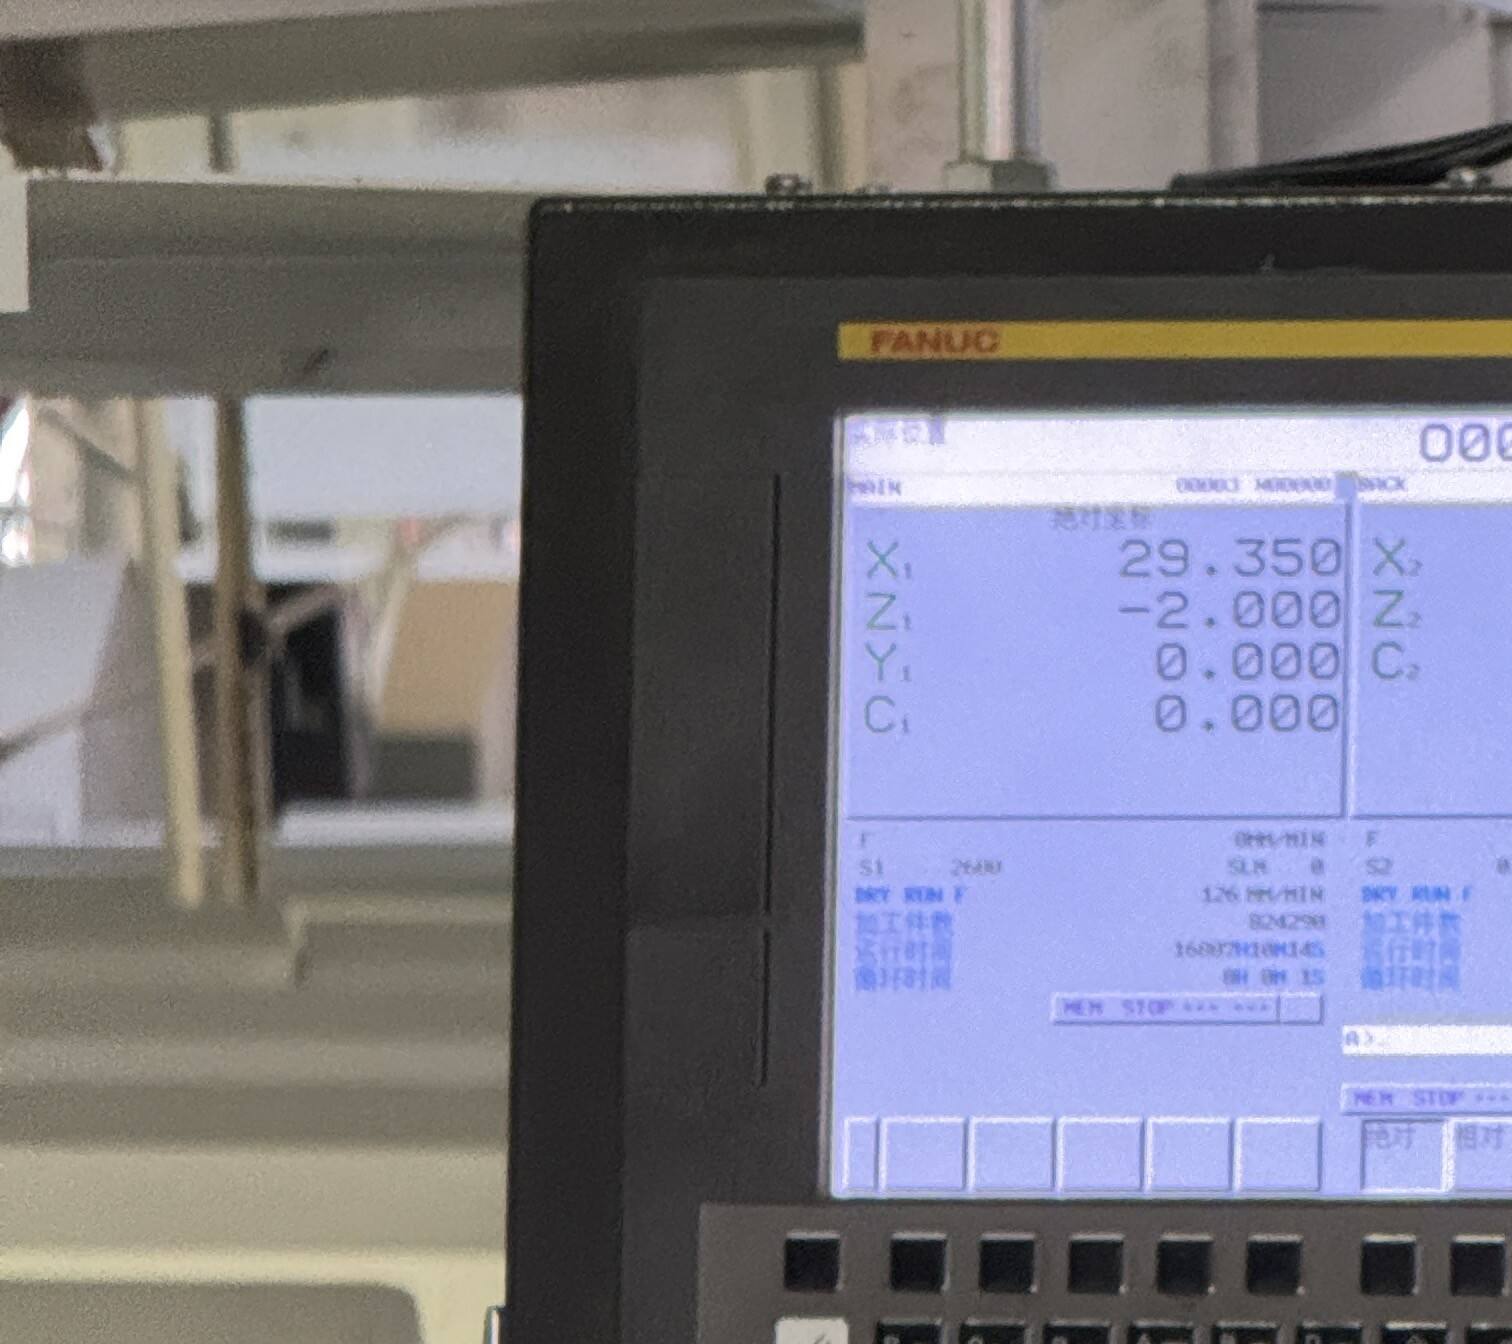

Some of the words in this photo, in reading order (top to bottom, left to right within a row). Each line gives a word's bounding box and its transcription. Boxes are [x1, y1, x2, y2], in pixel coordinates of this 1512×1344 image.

[870, 328, 1000, 353] FANUC
[1119, 539, 1342, 578] 29.350
[1118, 590, 1341, 629] -2.000
[1155, 642, 1340, 681] 0.000
[1154, 693, 1340, 733] 0.000
